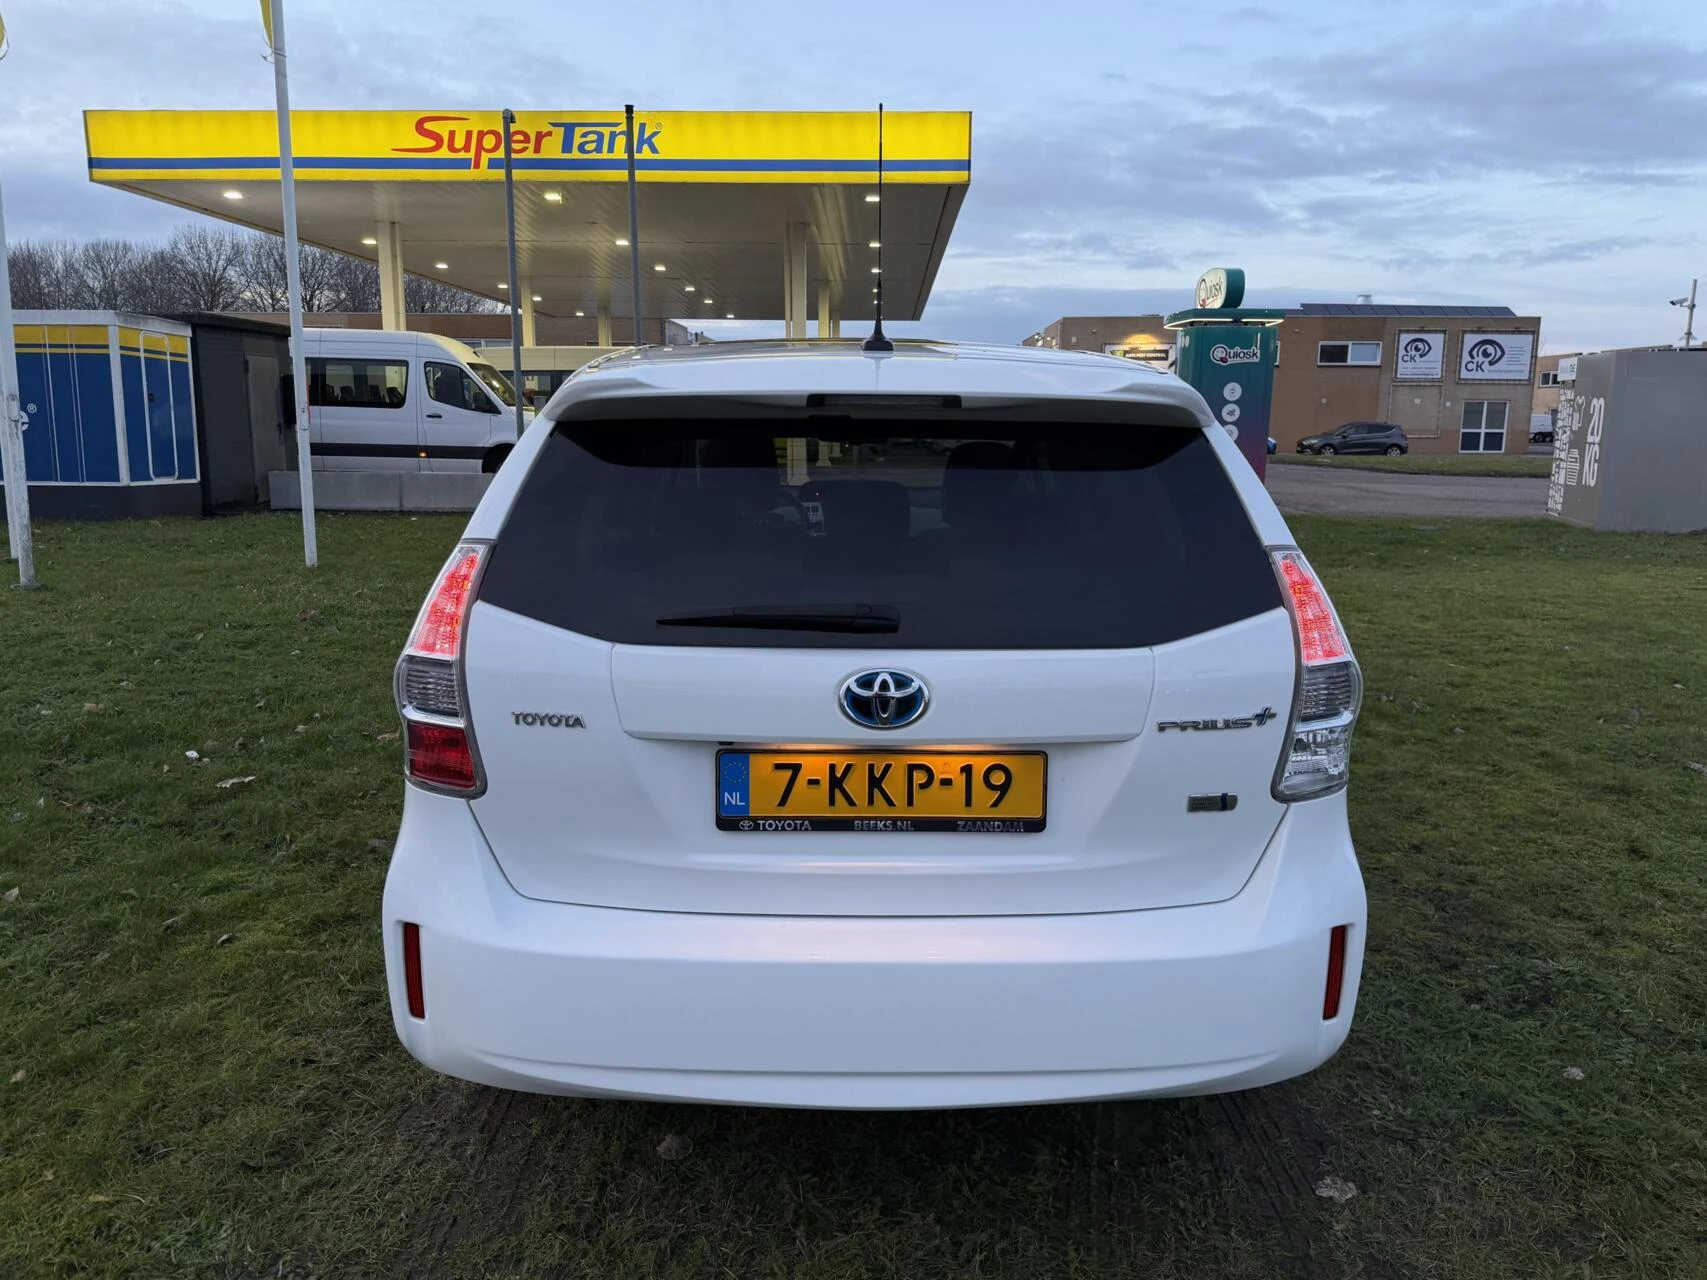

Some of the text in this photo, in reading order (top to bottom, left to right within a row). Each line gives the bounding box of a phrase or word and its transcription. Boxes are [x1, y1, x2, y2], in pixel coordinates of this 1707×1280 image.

[1211, 345, 1260, 364] Quiosk
[1401, 354, 1417, 363] CK
[1464, 360, 1485, 372] CK
[1587, 397, 1605, 443] 20
[1582, 443, 1600, 487] KG
[511, 712, 586, 729] TOYOTA
[772, 762, 1014, 808] 7-KKP-19
[723, 792, 746, 806] NL
[757, 820, 1025, 832] TOYOTA BEEKS.NL ZAANDAM
